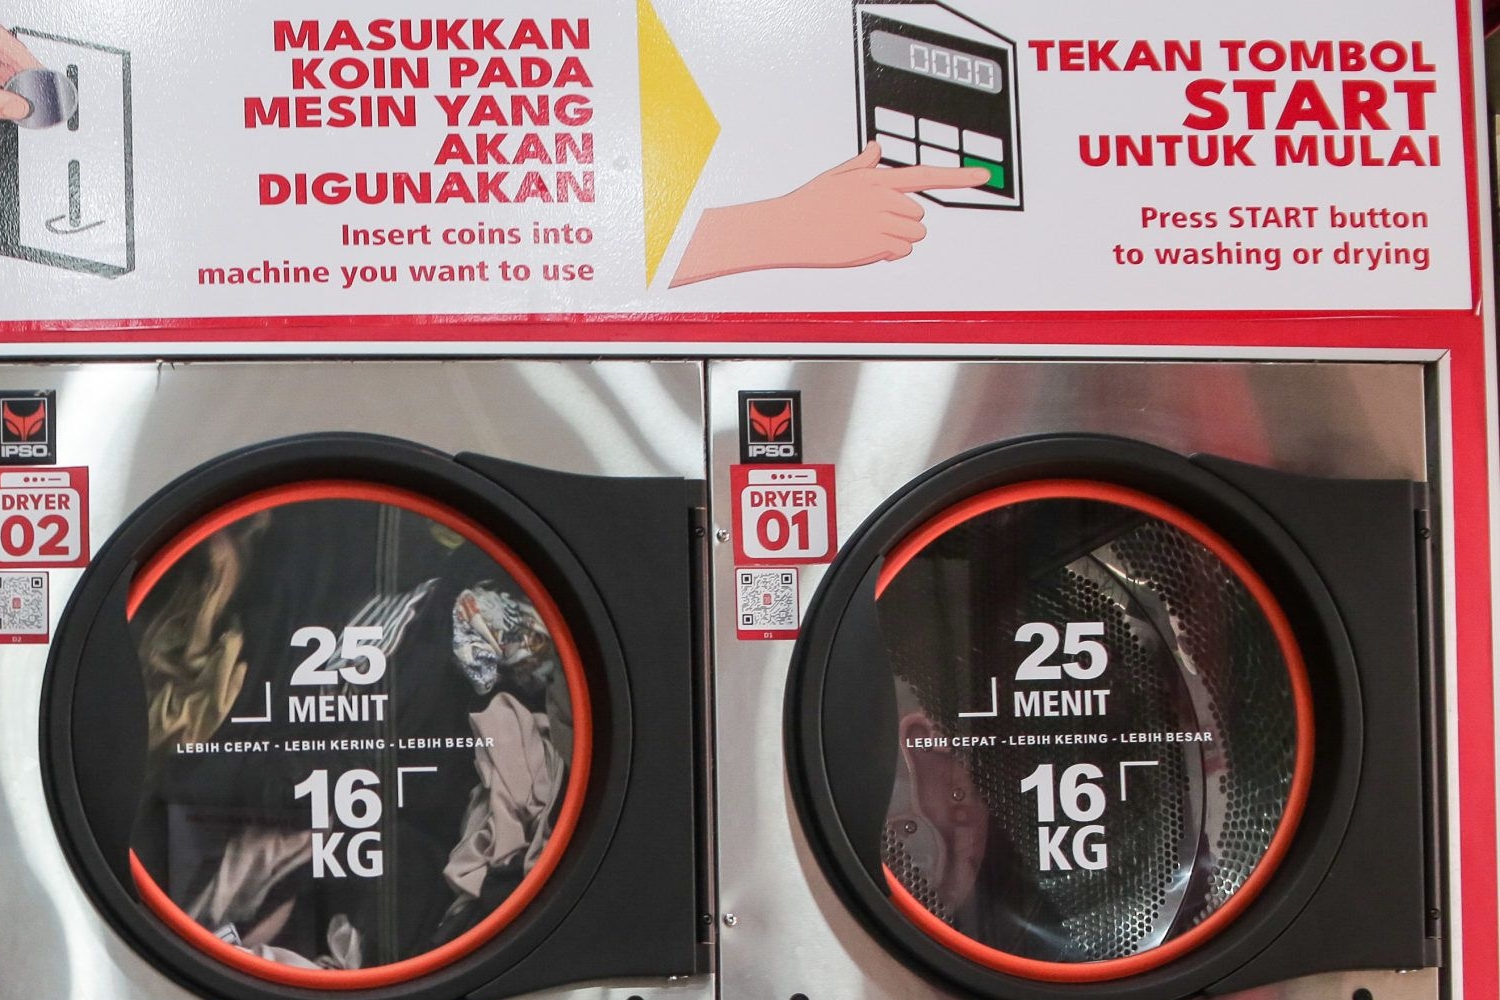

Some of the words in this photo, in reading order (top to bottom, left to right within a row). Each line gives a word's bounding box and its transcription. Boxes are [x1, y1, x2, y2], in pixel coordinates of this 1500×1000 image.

[274, 18, 590, 52] MASUKKAN
[1028, 40, 1202, 71] TEKAN
[1224, 40, 1436, 72] TOMBOL
[292, 57, 429, 90] KOIN
[449, 56, 593, 88] PADA
[244, 95, 416, 128] MESIN
[434, 94, 593, 127] YANG
[1182, 79, 1436, 131] START
[434, 133, 595, 165] AKAN
[1079, 135, 1256, 167] UNTUK
[1277, 135, 1440, 167] MULAI
[259, 171, 595, 205] DIGUNAKAN
[1141, 207, 1217, 228] Press
[1229, 207, 1318, 228] START
[1330, 205, 1428, 228] button
[342, 224, 431, 245] Insert
[442, 222, 521, 245] coins
[533, 221, 593, 244] into
[1113, 244, 1144, 265] to
[1154, 241, 1281, 271] washing
[1293, 248, 1323, 264] or
[1333, 241, 1429, 271] drying
[198, 260, 329, 284] machine
[341, 266, 397, 289] you
[409, 261, 489, 282] want
[498, 261, 530, 281] to
[543, 264, 594, 281] use
[1, 445, 47, 458] IPSO
[748, 445, 794, 458] IPSO
[2, 494, 70, 510] DRYER
[750, 490, 817, 507] DRYER
[0, 515, 69, 556] 02
[757, 509, 809, 551] 01
[290, 626, 387, 686] 25
[1014, 622, 1108, 680] 25
[289, 694, 389, 723] MENIT
[1014, 689, 1110, 717] MENIT
[177, 742, 219, 753] LEBIH
[224, 741, 270, 752] CEPAT
[285, 740, 325, 751] LEBIH
[330, 739, 385, 750] KERING
[399, 738, 441, 749] LEBIH
[446, 738, 494, 748] BESAR
[906, 737, 947, 748] LEBIH
[952, 736, 996, 747] CEPAT
[1009, 735, 1050, 745] LEBIH
[1055, 734, 1108, 744] KERING
[1121, 733, 1162, 743] LEBIH
[1166, 732, 1212, 742] BESAR
[294, 769, 382, 829] 16
[1021, 763, 1106, 822] 16
[312, 832, 383, 878] KG
[1038, 825, 1108, 871] KG
